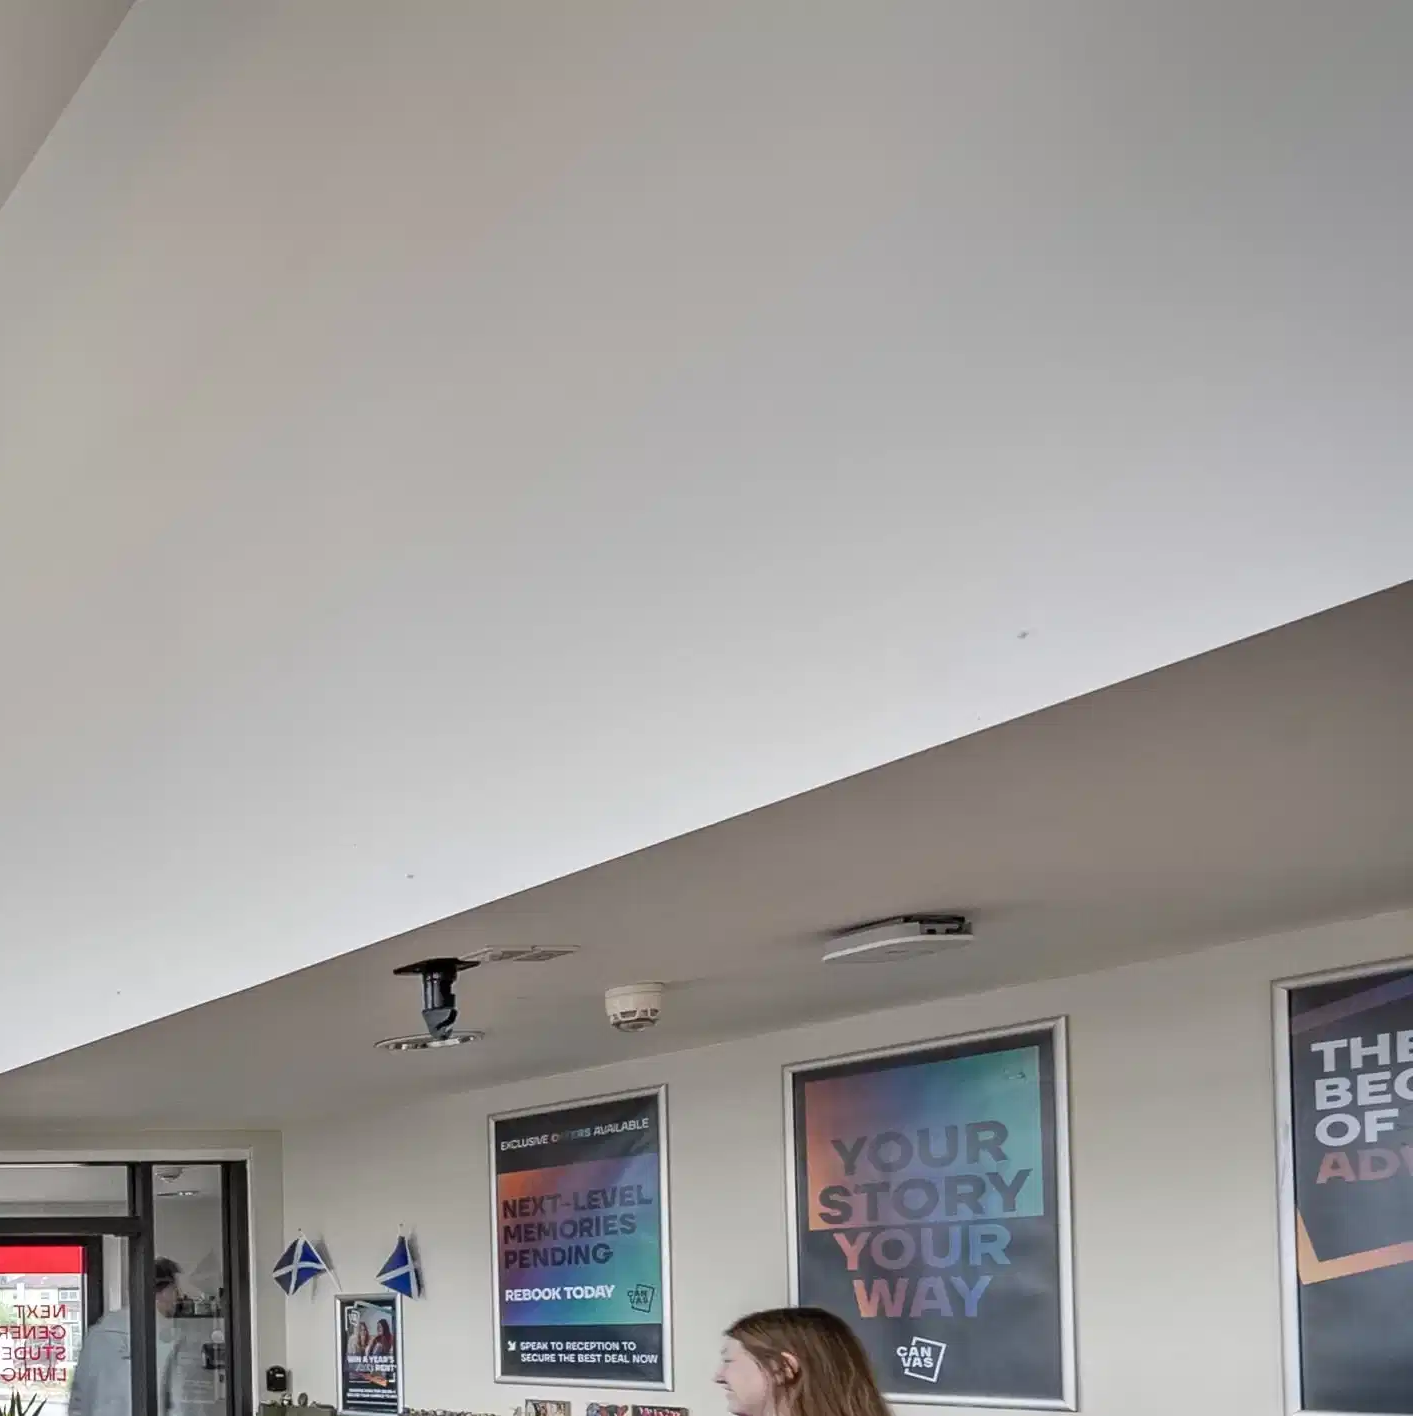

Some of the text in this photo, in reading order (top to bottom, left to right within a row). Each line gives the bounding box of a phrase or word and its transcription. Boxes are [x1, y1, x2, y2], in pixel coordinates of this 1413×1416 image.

[501, 1117, 650, 1151] EXCLUSIVE OERS AVAILABLE
[1315, 1108, 1399, 1147] OF
[831, 1120, 1009, 1176] YOUR
[502, 1185, 653, 1219] NEXT-LEVEL
[818, 1168, 1033, 1225] STORY
[503, 1213, 637, 1245] MEMORIES
[504, 1243, 614, 1269] PENDING
[833, 1223, 1012, 1272] YOUR
[505, 1285, 615, 1302] REBOOK TODAY
[852, 1275, 994, 1318] WAY
[519, 1341, 637, 1351] SPEAK TO RECEPTION TO
[520, 1353, 659, 1364] SECURE THE BEST DEAL NOW
[896, 1346, 932, 1357] CAN
[901, 1356, 934, 1368] VAS
